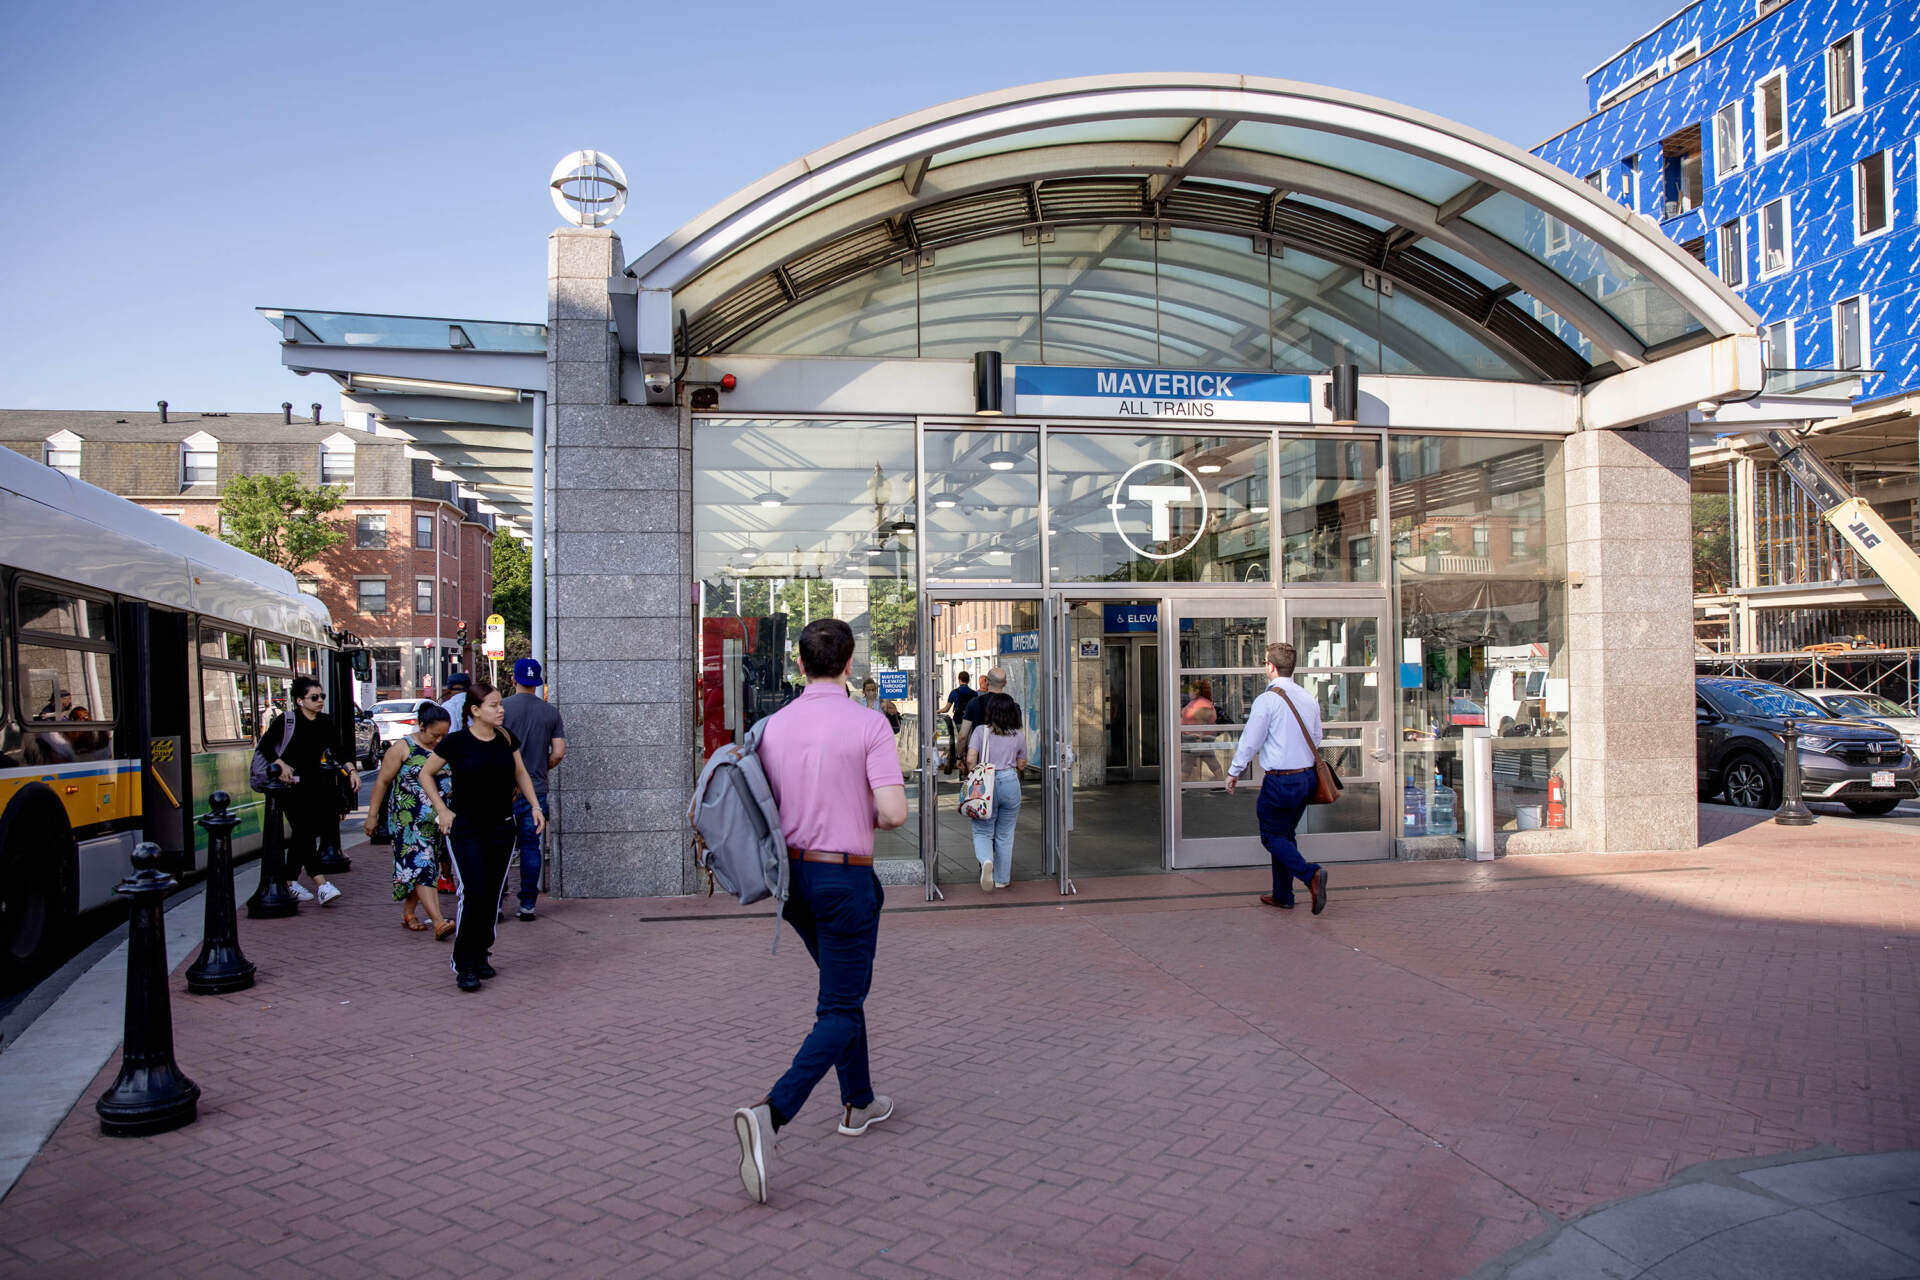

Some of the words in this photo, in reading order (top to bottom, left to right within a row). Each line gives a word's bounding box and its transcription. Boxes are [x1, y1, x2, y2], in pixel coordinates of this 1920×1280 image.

[1097, 372, 1234, 397] MAVERICK
[1119, 400, 1149, 415] ALL
[1153, 401, 1214, 417] TRAINS
[1128, 485, 1192, 541] T
[1848, 521, 1882, 549] JLG
